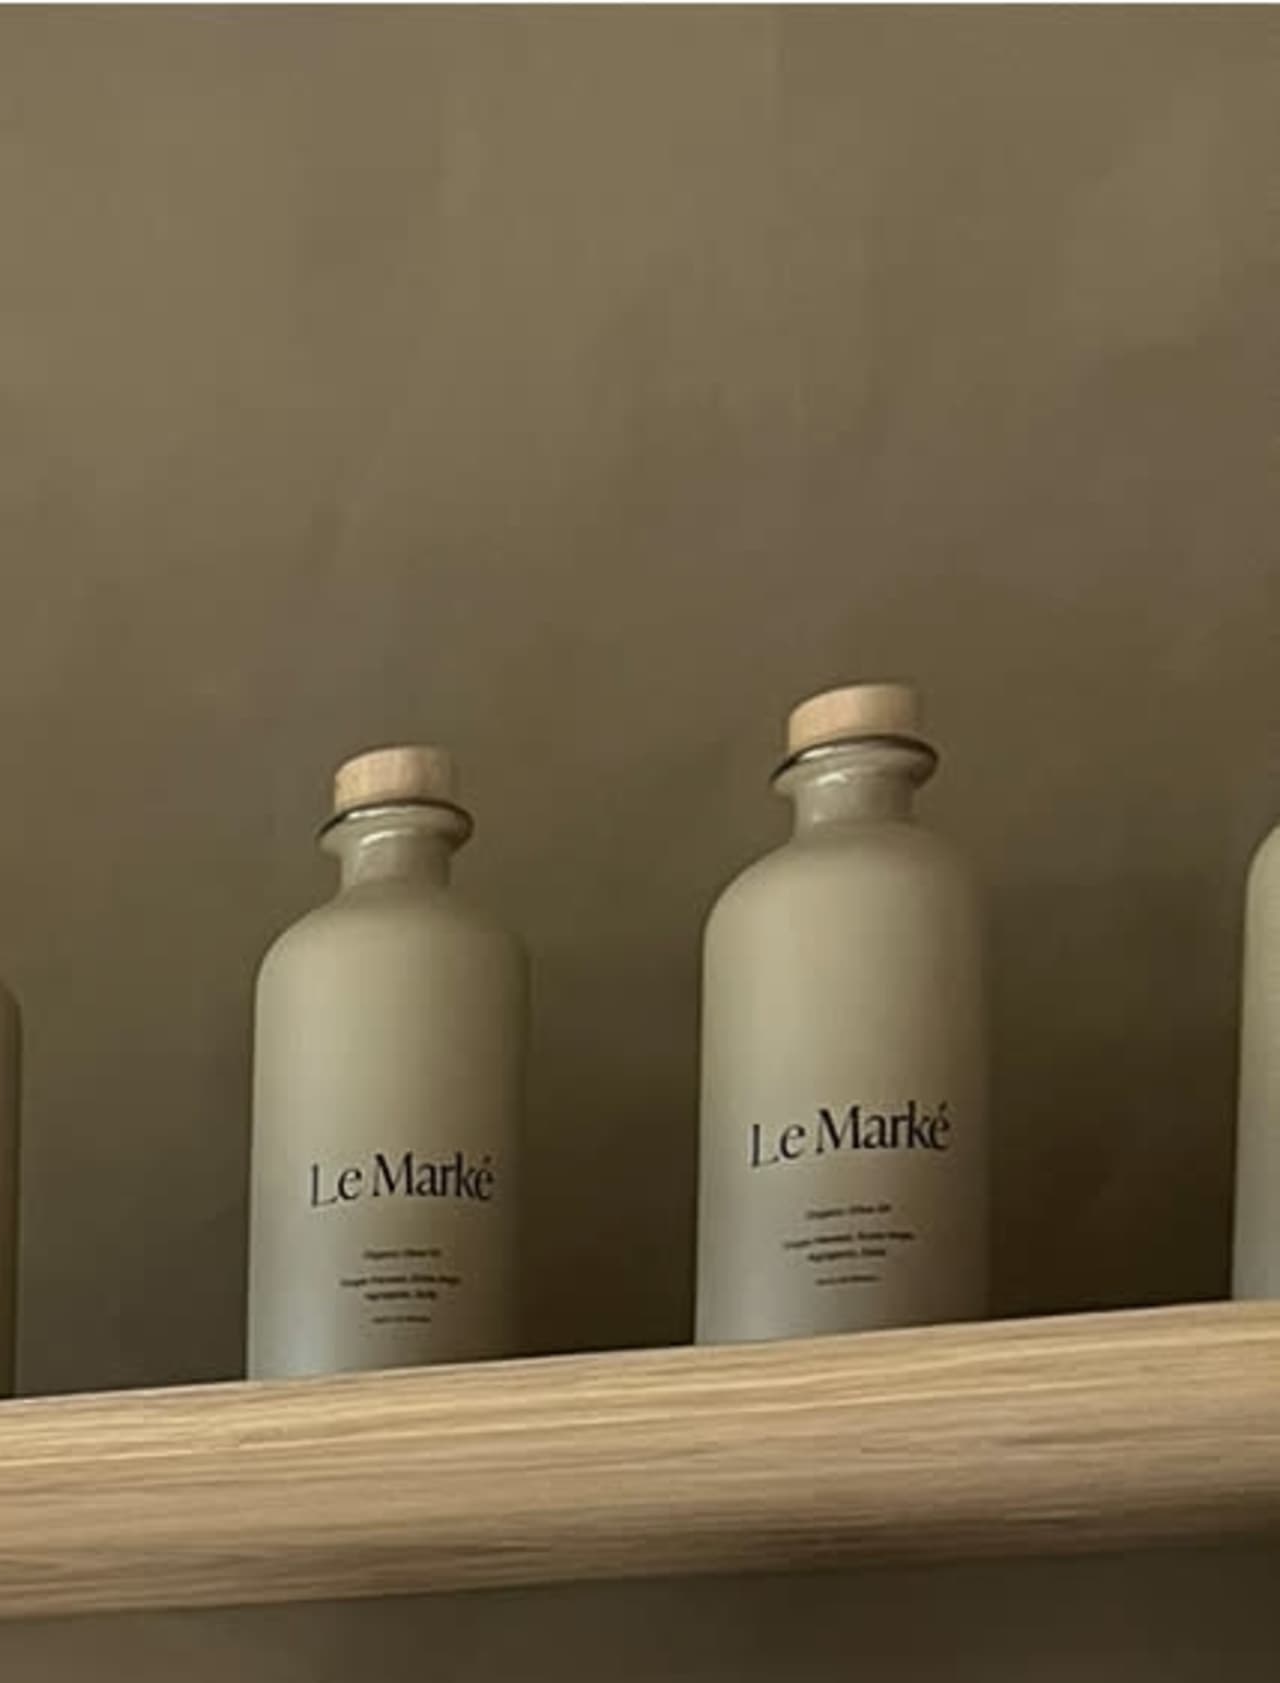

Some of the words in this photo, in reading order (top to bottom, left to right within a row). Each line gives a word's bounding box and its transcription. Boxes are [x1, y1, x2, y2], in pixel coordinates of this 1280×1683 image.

[749, 1122, 806, 1169] Le
[814, 1099, 952, 1155] Marké
[310, 1161, 363, 1208] Le
[371, 1150, 496, 1202] Marké
